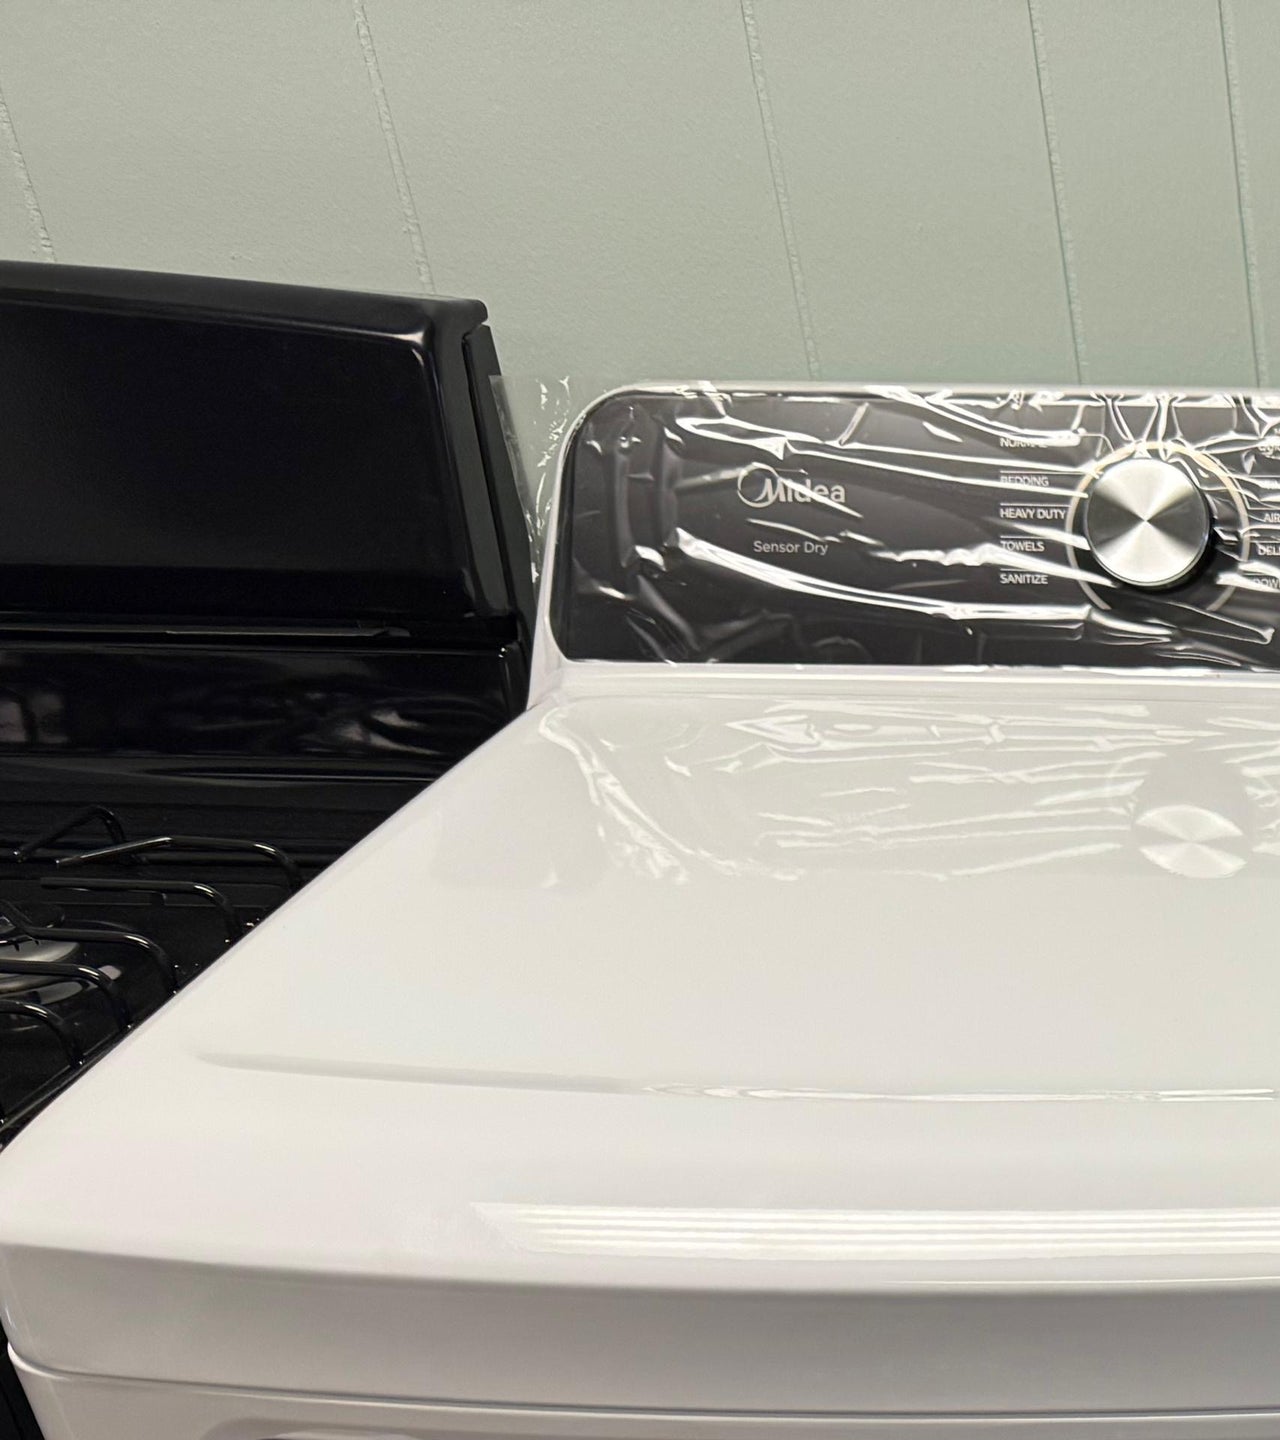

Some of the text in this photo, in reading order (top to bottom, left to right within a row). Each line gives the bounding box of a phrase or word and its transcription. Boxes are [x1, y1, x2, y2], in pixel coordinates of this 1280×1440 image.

[1000, 508, 1067, 520] HEAVY DUTY
[753, 540, 829, 556] Sensor Dry
[1000, 540, 1046, 552] TOWELS
[1000, 573, 1049, 585] SANITIZE
